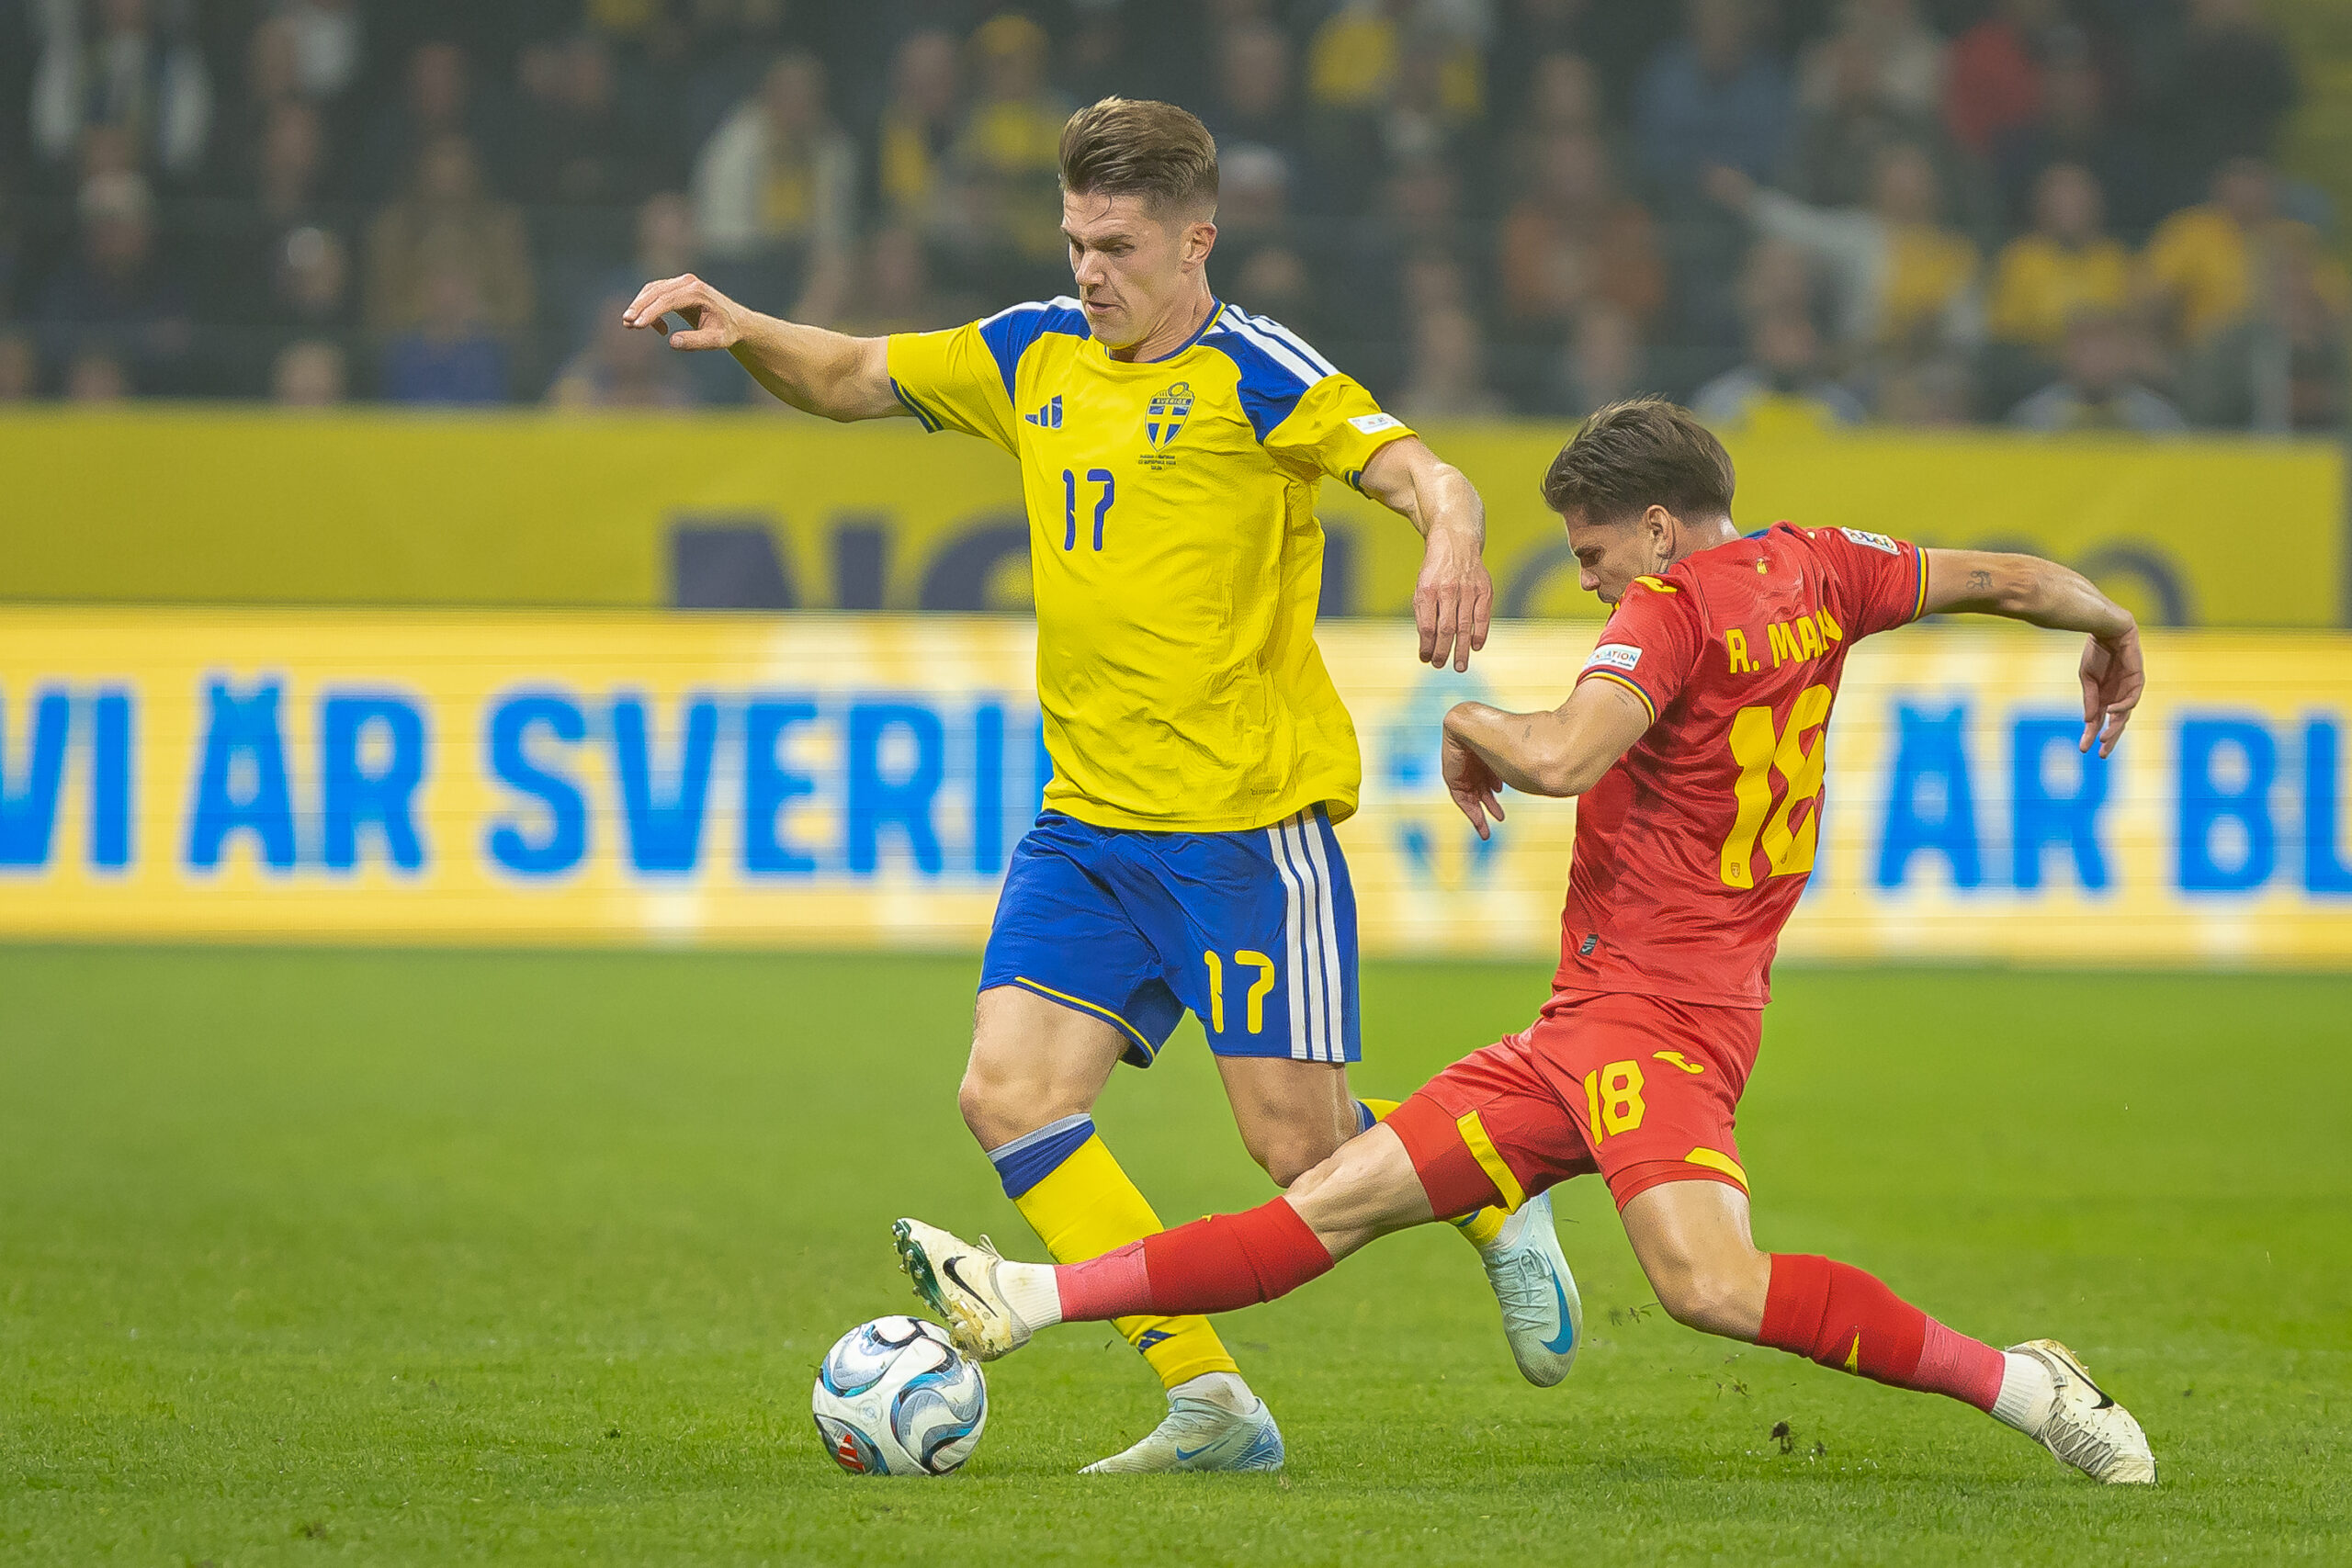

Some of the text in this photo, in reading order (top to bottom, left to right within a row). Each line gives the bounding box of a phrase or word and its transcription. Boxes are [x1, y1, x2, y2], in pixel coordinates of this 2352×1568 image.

[1063, 468, 1114, 551] 17
[1725, 628, 1760, 674] R.
[188, 678, 427, 871] ÄR
[490, 689, 1053, 874] SVERI
[1720, 683, 1832, 889] 18
[1876, 700, 2109, 891] ÄR
[1204, 950, 1275, 1034] 17
[1584, 1059, 1646, 1146] 18
